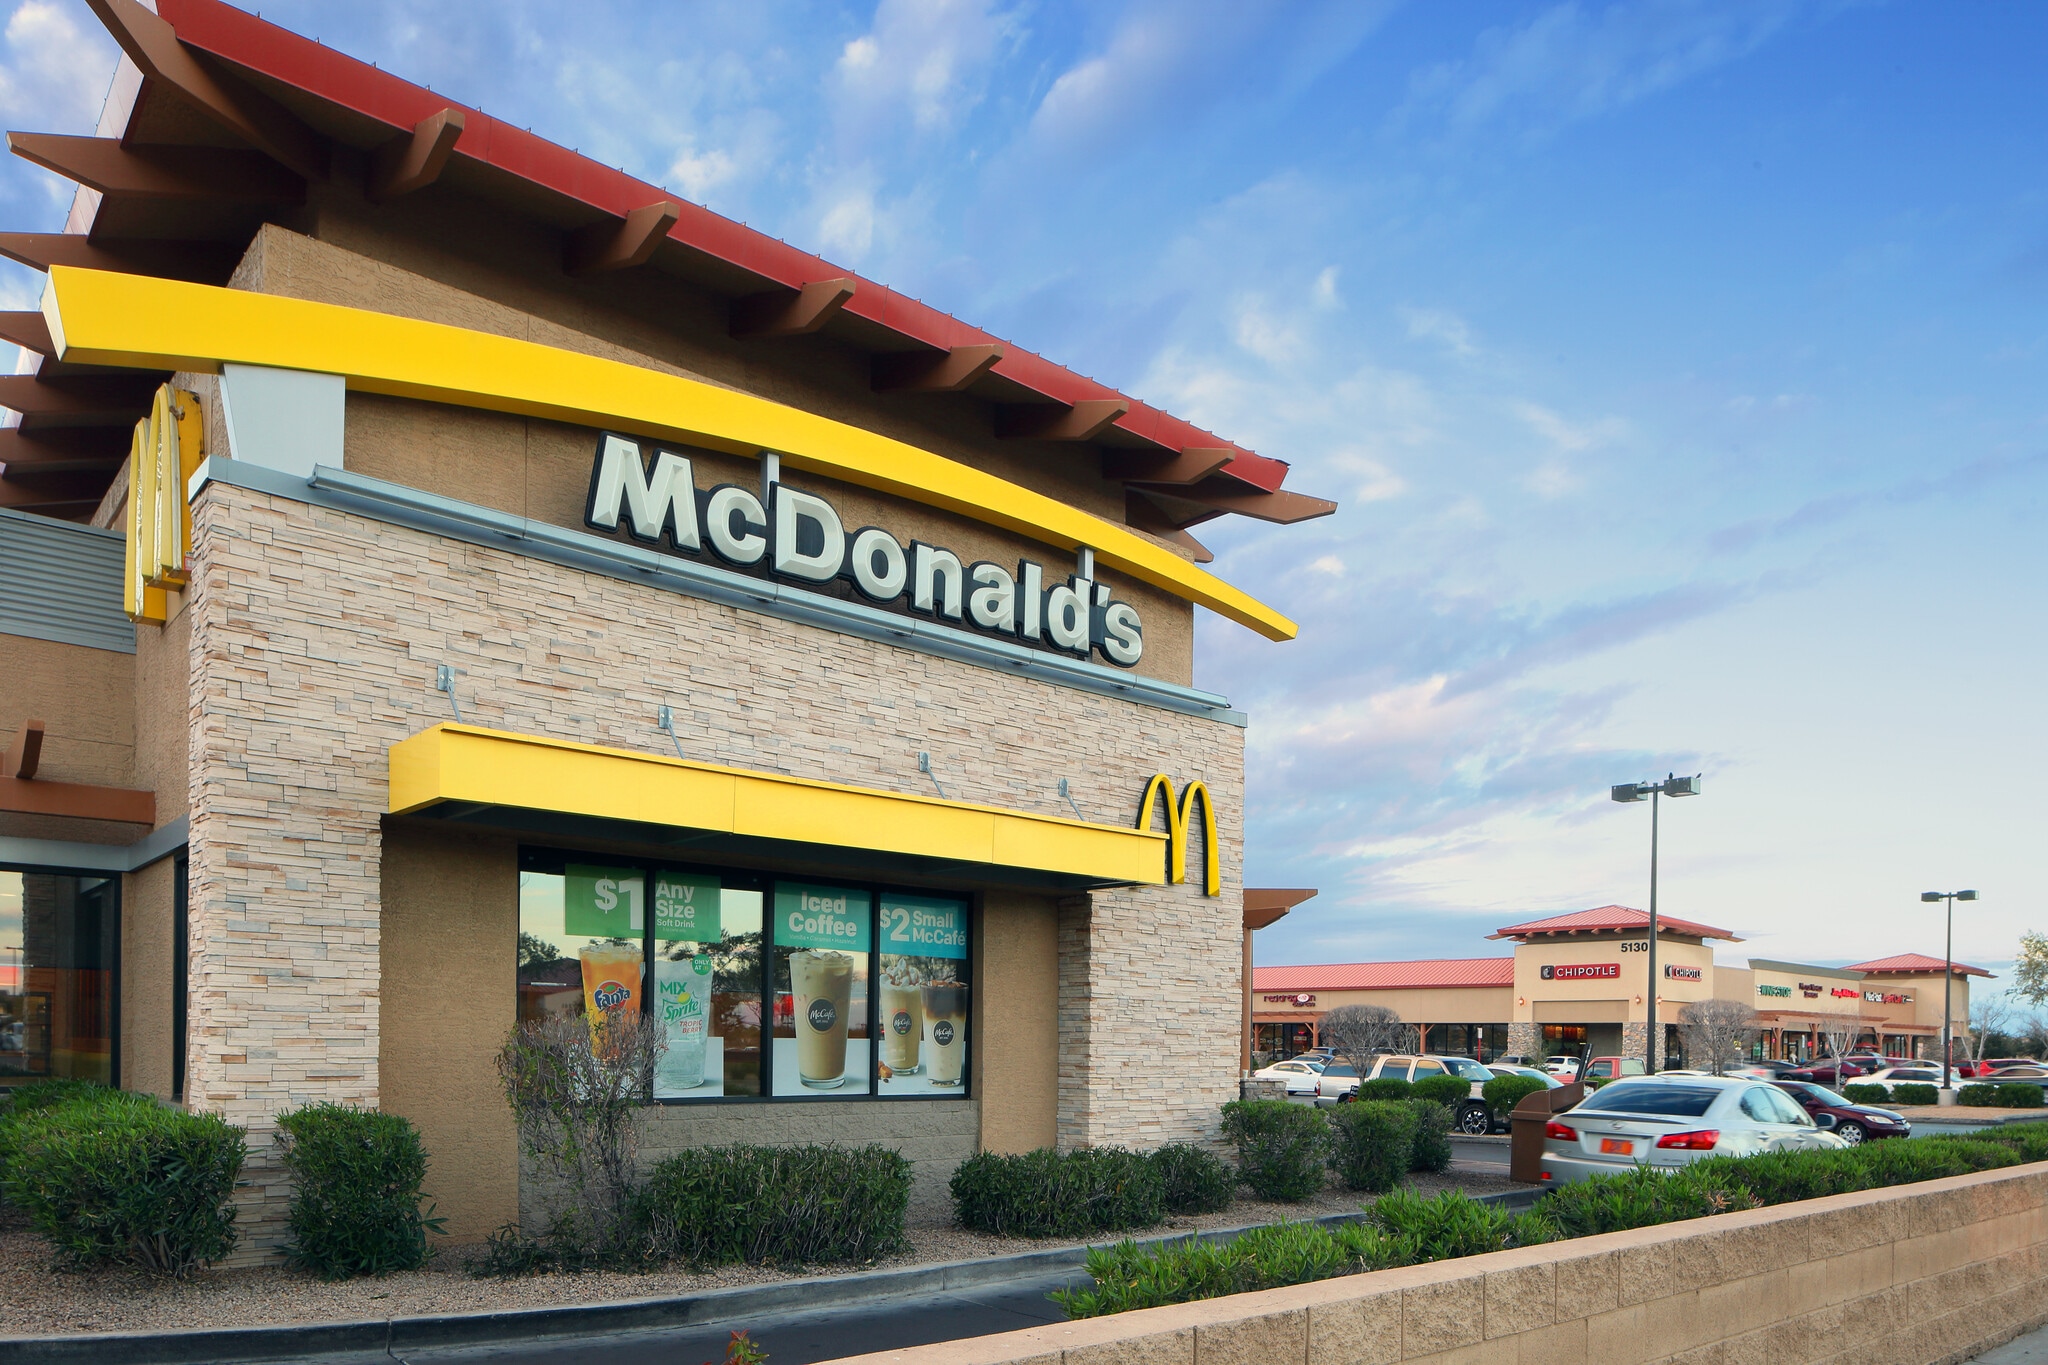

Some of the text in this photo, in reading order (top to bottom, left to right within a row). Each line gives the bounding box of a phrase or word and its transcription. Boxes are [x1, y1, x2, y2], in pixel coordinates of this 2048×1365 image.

[589, 432, 1144, 664] McDonald's
[655, 879, 695, 904] Any
[594, 876, 643, 930] $1
[655, 899, 695, 919] Size
[801, 891, 847, 915] Iced
[656, 918, 695, 928] Soft Drink
[788, 912, 857, 937] Coffee
[879, 907, 910, 942] $2
[912, 910, 954, 929] Small
[912, 927, 966, 947] McCafé
[1620, 942, 1649, 953] 5130
[1556, 966, 1617, 977] CHIPOTLE
[660, 980, 687, 995] MIX
[594, 987, 631, 1011] Fanta
[663, 1000, 699, 1020] Sprite
[679, 1019, 703, 1027] TROPIC
[682, 1026, 703, 1034] BERRY
